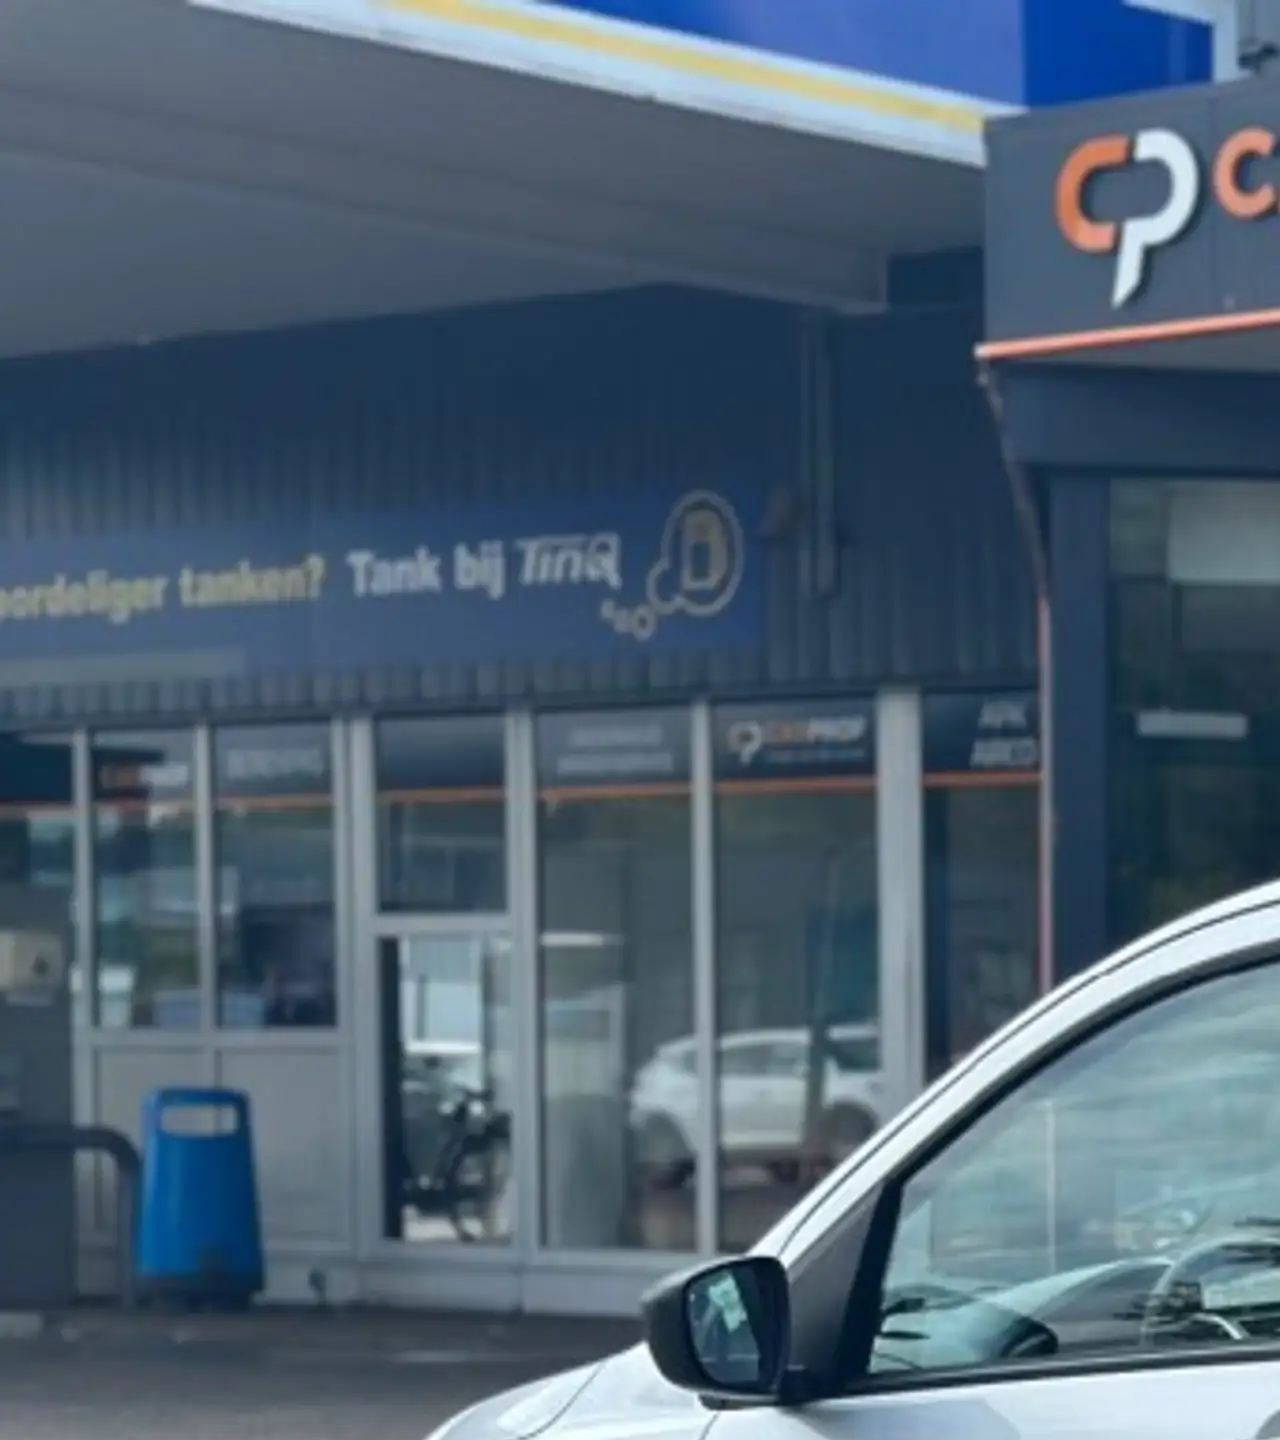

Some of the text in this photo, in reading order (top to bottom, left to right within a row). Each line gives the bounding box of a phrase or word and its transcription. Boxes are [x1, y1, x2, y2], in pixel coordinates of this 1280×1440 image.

[179, 551, 327, 608] tanken?
[345, 545, 443, 598] Tank
[453, 539, 506, 600] bij
